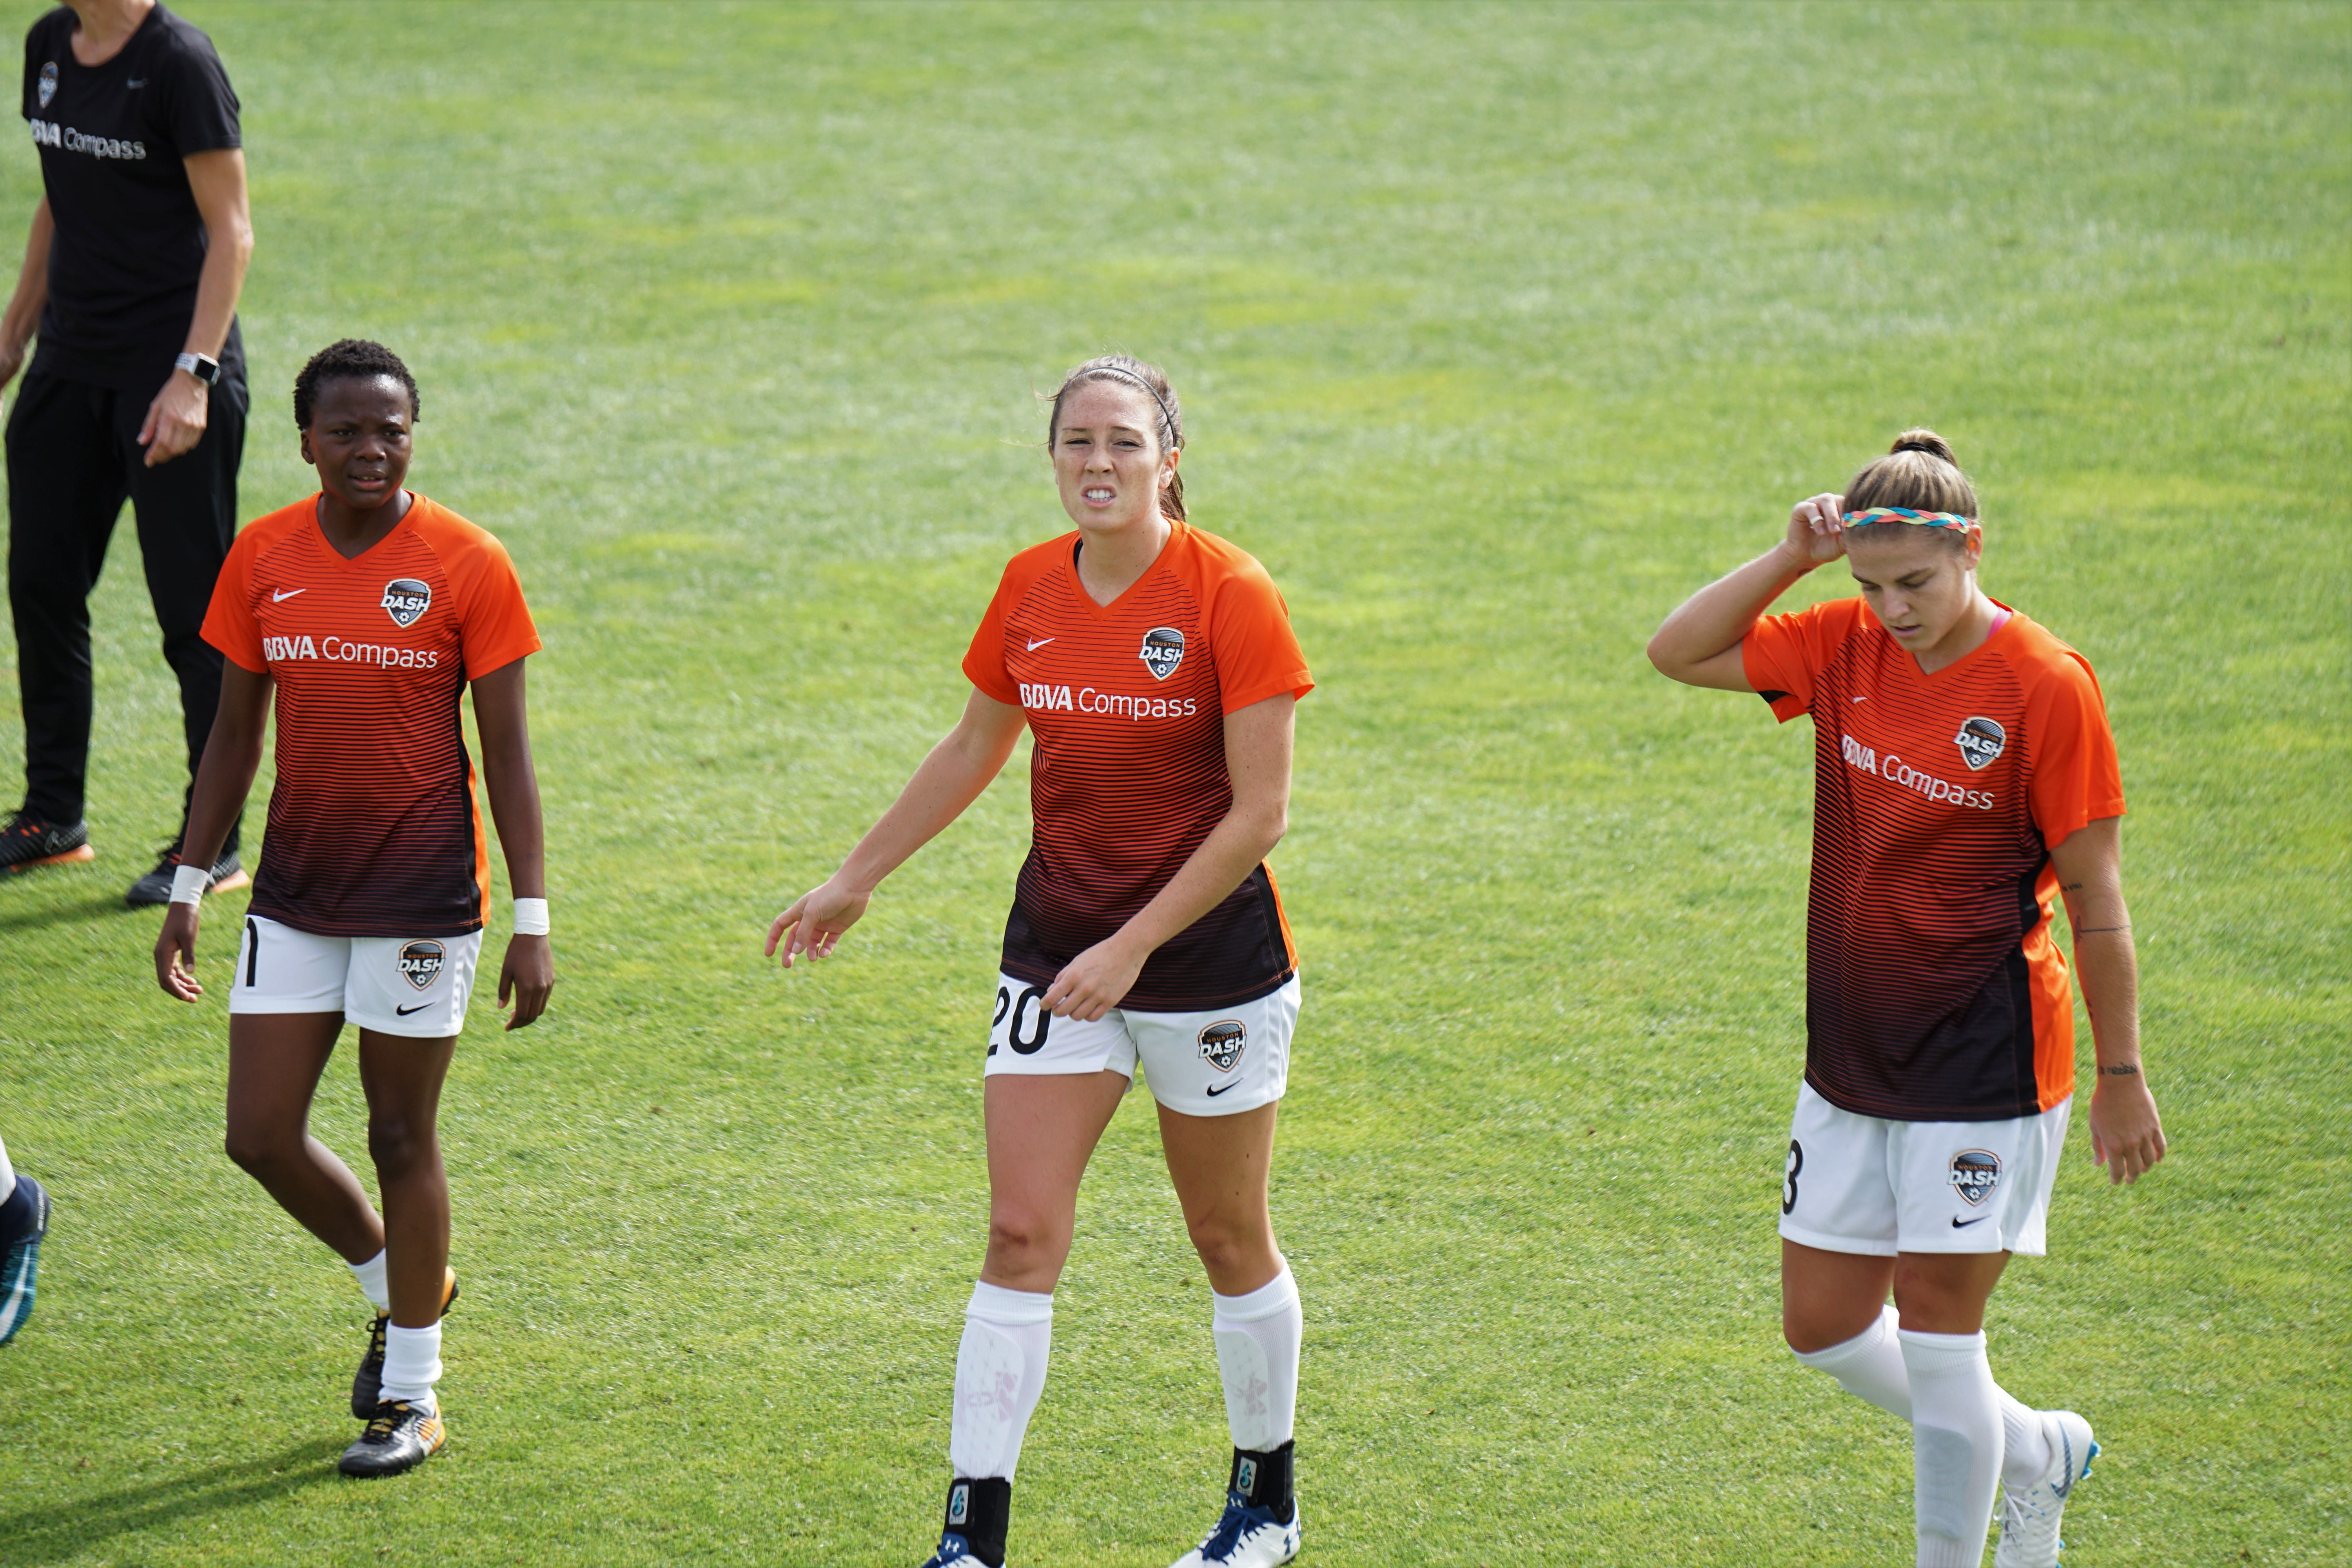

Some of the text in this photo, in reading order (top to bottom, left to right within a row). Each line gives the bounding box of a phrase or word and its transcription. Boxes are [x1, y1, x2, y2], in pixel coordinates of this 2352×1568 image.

[64, 127, 146, 160] Compass
[380, 595, 431, 612] DASH
[263, 636, 437, 669] BBVA Compass
[1138, 646, 1184, 662] DASH
[1020, 683, 1196, 721] BBVA Compass
[1953, 730, 2005, 759] DASH
[1842, 734, 1995, 810] BBVA Compass
[396, 958, 445, 972] DASH
[987, 986, 1053, 1054] 20
[1199, 1035, 1247, 1058] DASH
[1207, 1032, 1239, 1043] HOUSTON
[1948, 1170, 2002, 1186] DASH
